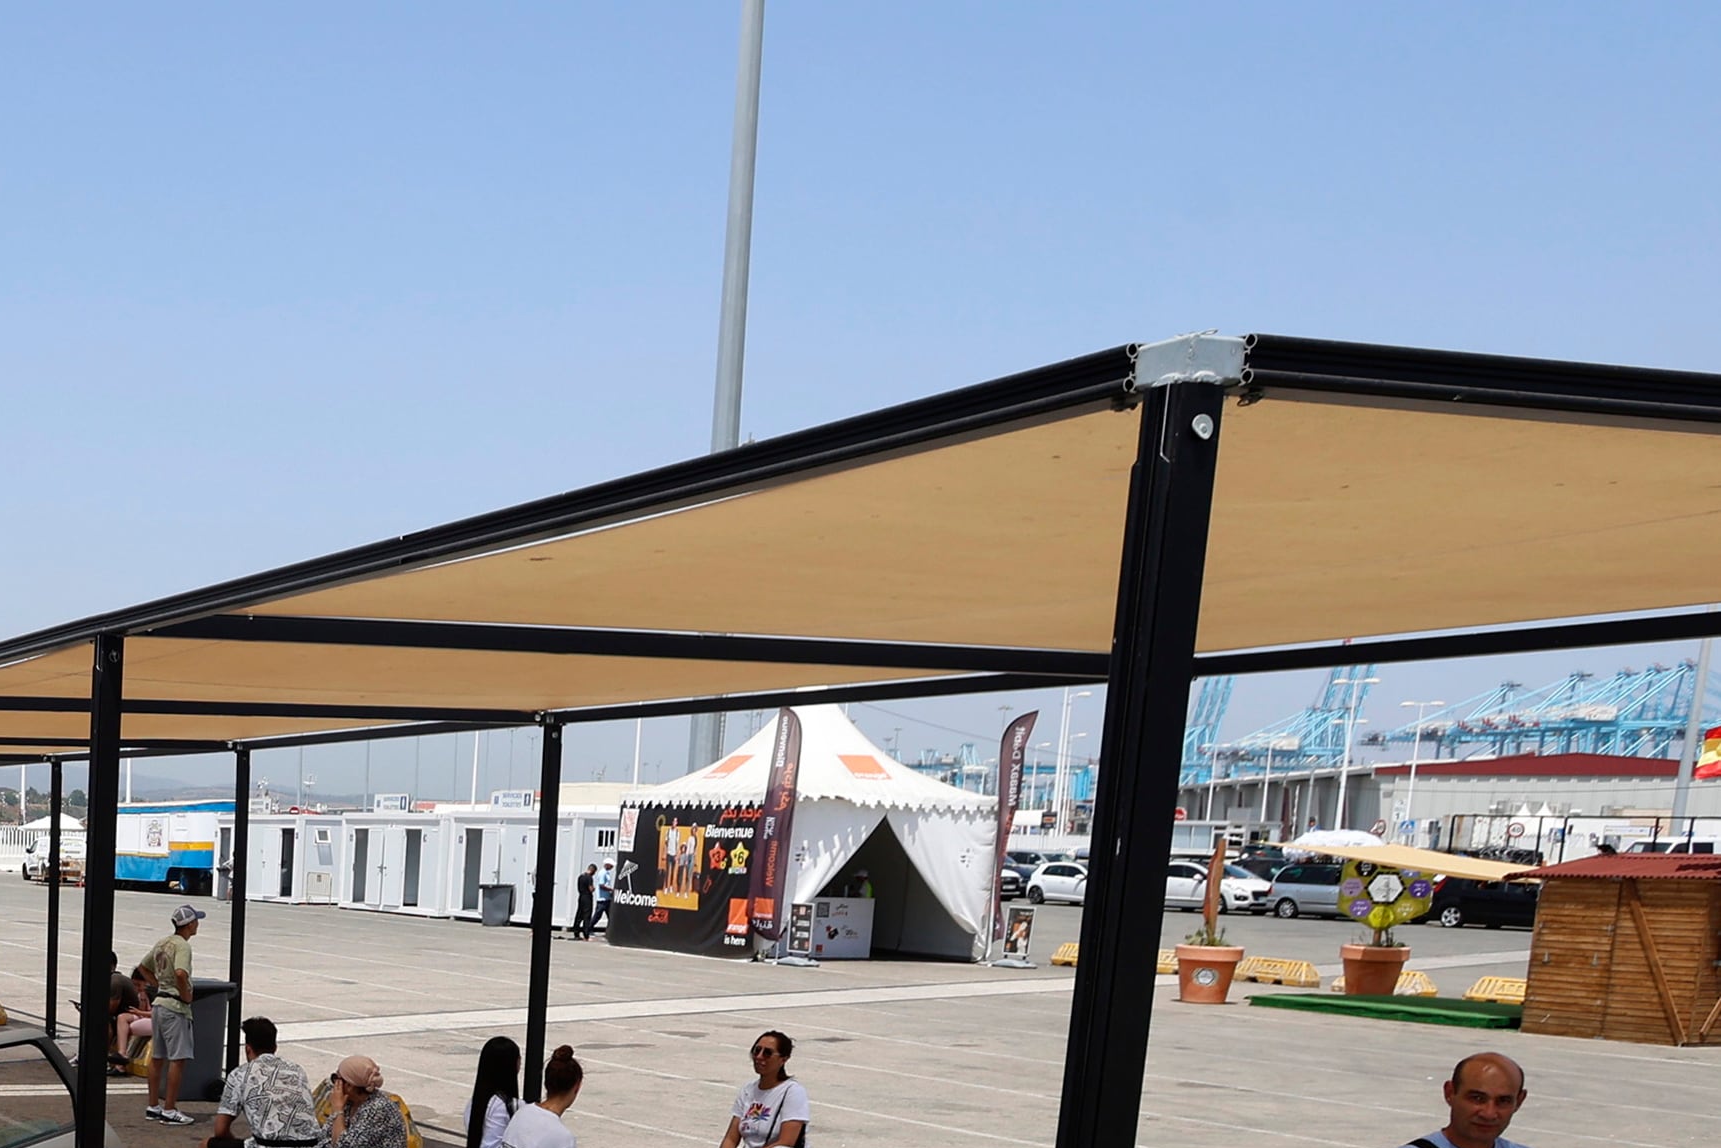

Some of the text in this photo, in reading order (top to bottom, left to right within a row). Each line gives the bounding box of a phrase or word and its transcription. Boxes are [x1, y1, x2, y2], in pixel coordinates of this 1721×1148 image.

[705, 824, 755, 839] Bienvenue
[613, 889, 658, 907] Welcome
[730, 935, 746, 946] here
